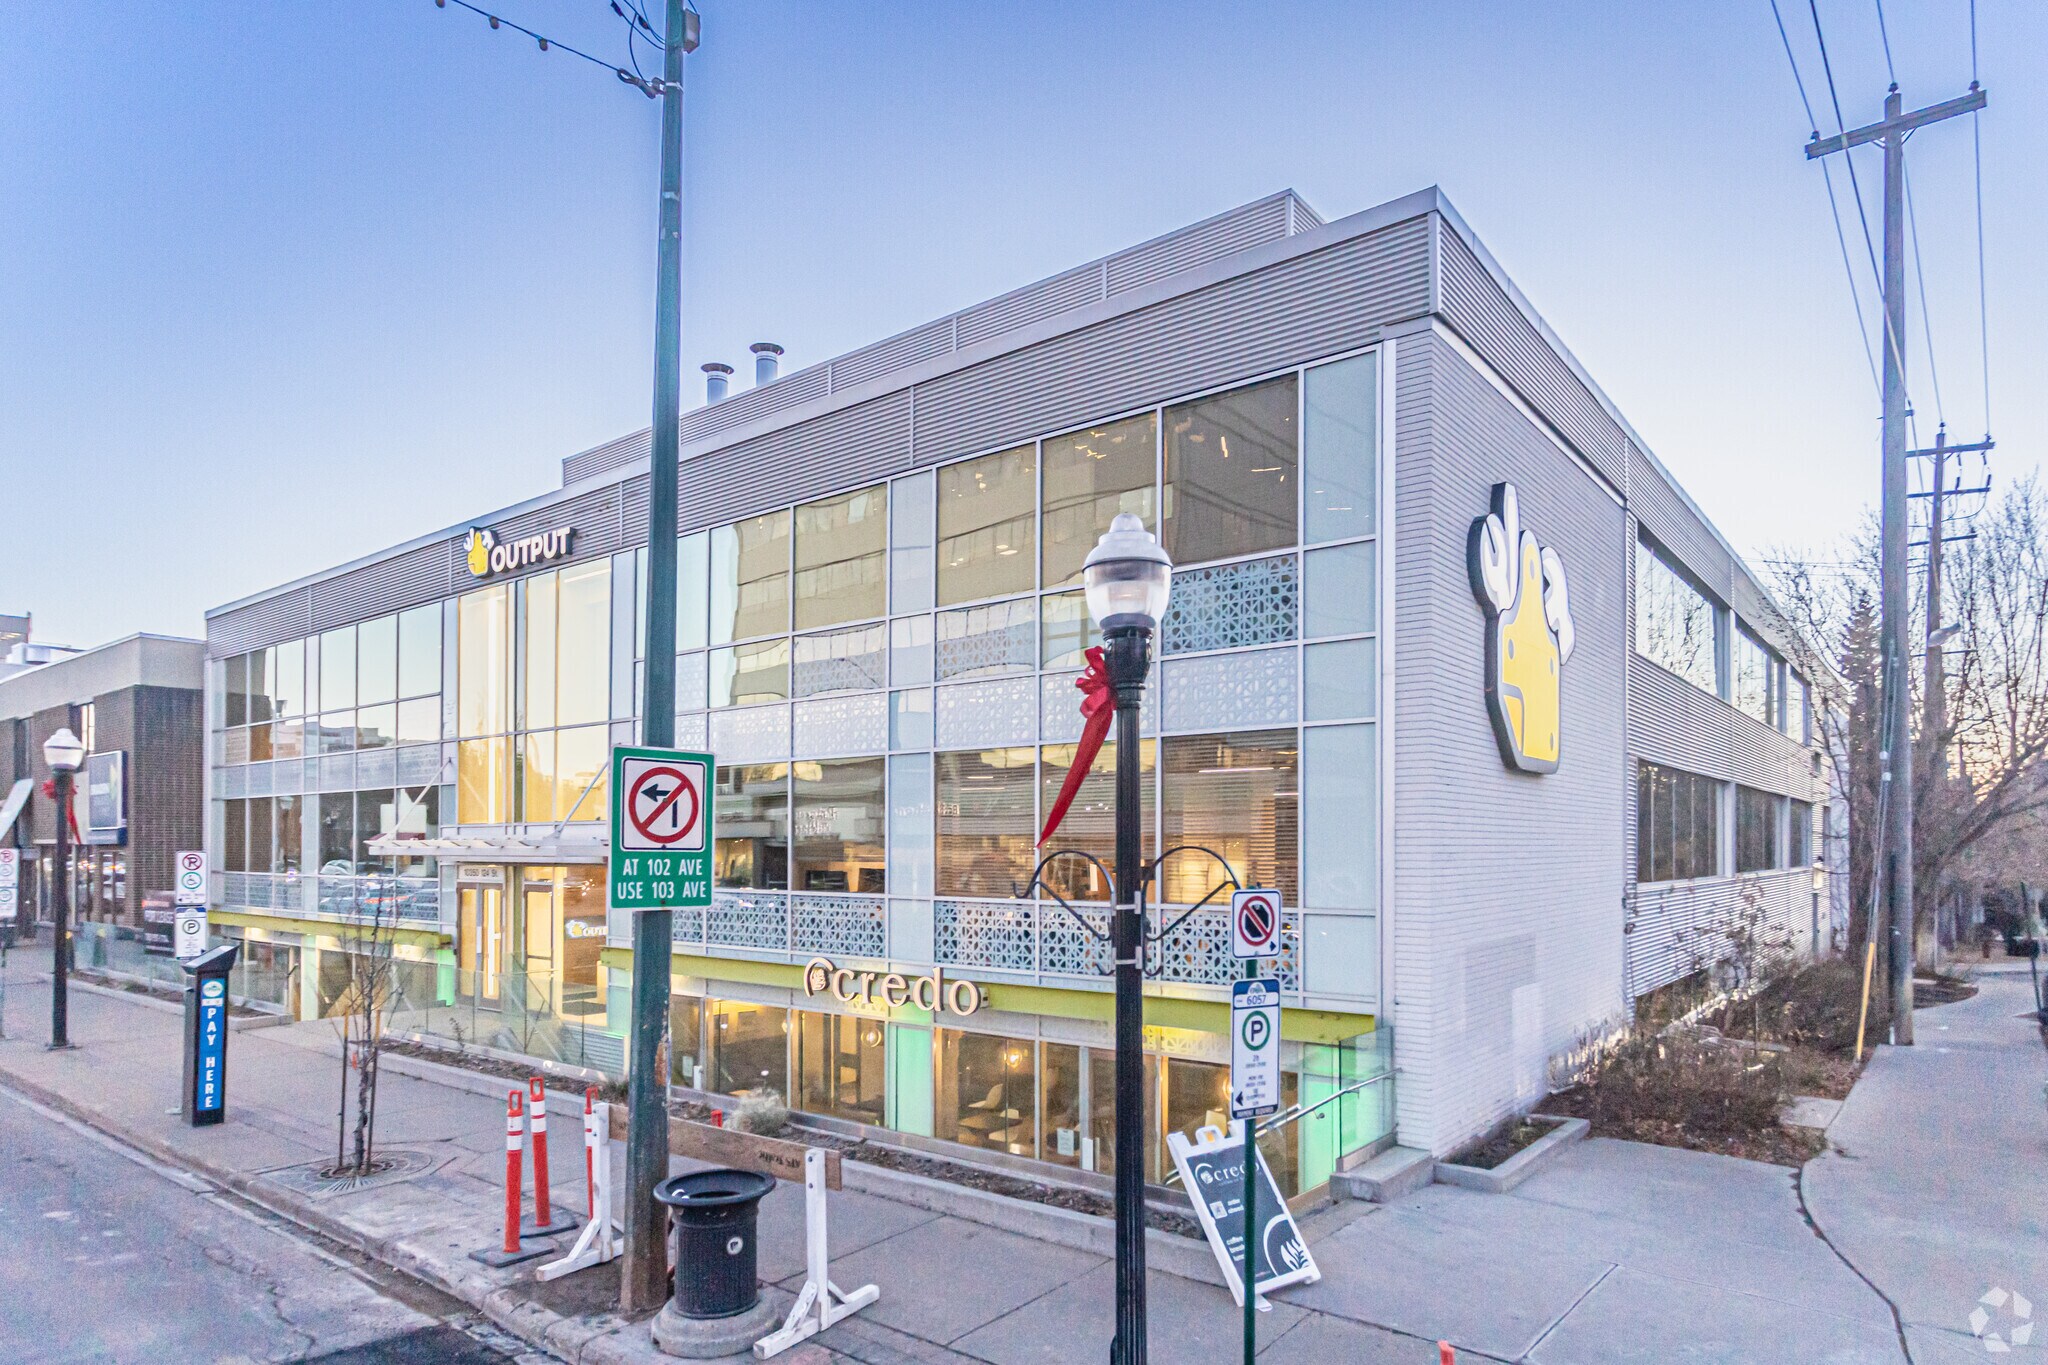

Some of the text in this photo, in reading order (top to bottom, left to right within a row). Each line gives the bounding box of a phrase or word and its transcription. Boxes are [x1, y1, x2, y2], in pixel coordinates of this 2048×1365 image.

[491, 527, 570, 572] OUTPUT
[623, 858, 702, 876] AT 102 AVE
[617, 881, 706, 899] USE 103 AVE
[832, 967, 979, 1016] credo
[1247, 994, 1266, 1005] 6057
[205, 1007, 217, 1108] PAY HERE
